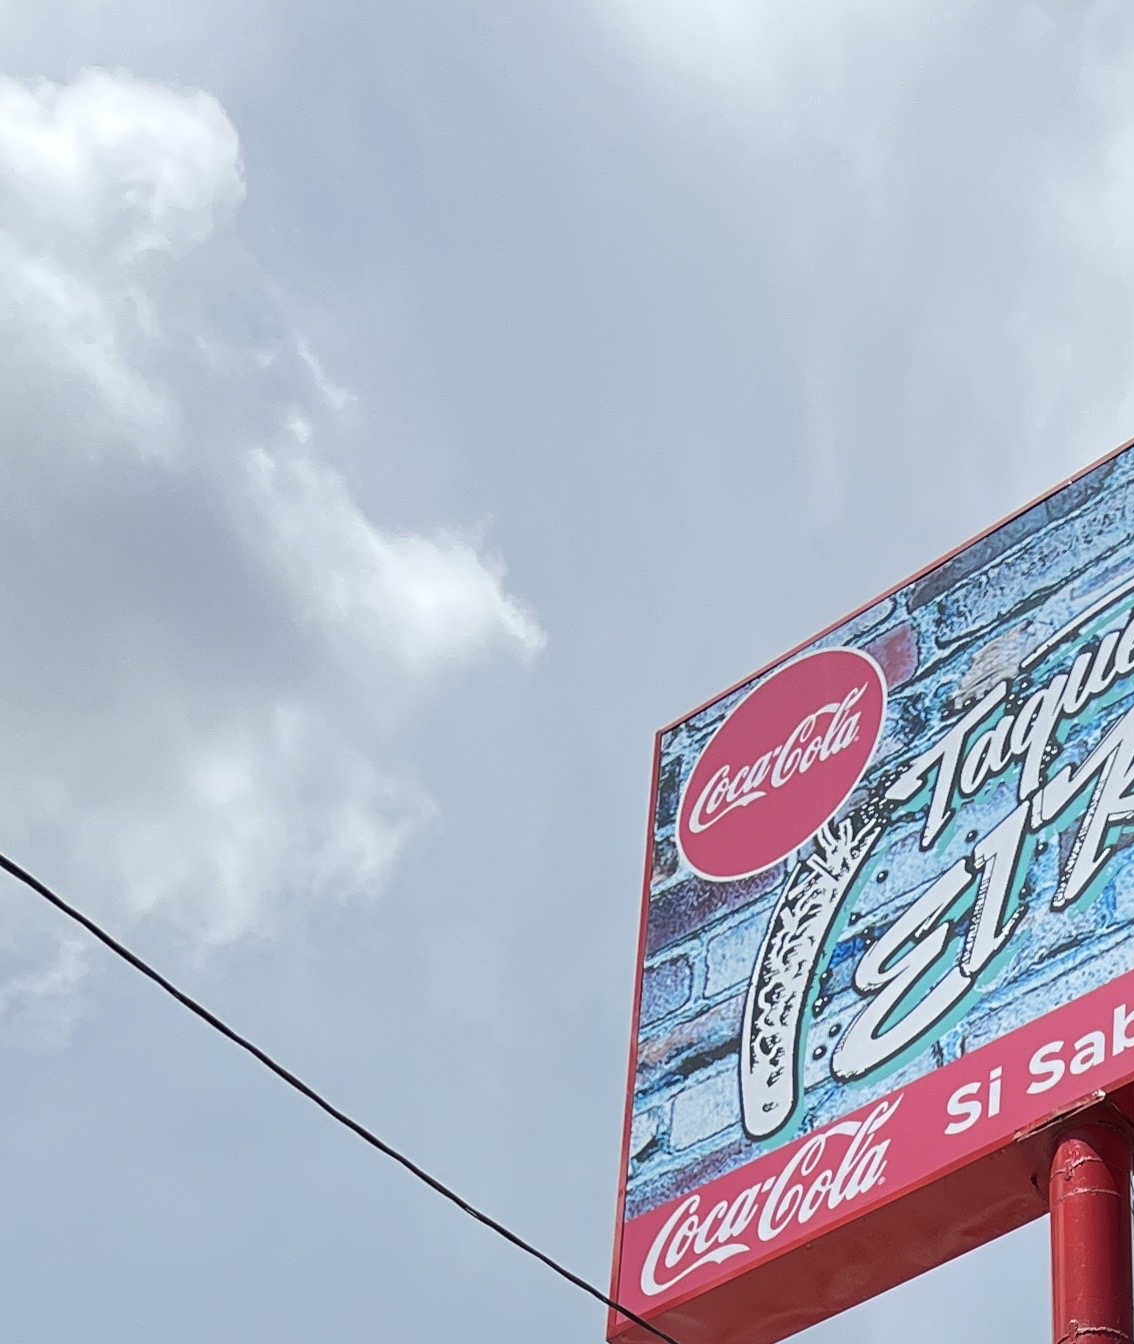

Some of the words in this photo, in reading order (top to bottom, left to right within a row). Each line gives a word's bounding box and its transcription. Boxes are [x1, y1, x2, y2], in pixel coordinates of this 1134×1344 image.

[689, 681, 869, 834] Coca-Cola
[832, 800, 1030, 1080] El
[641, 1092, 903, 1296] Coca-Cola
[944, 1066, 1002, 1135] Si
